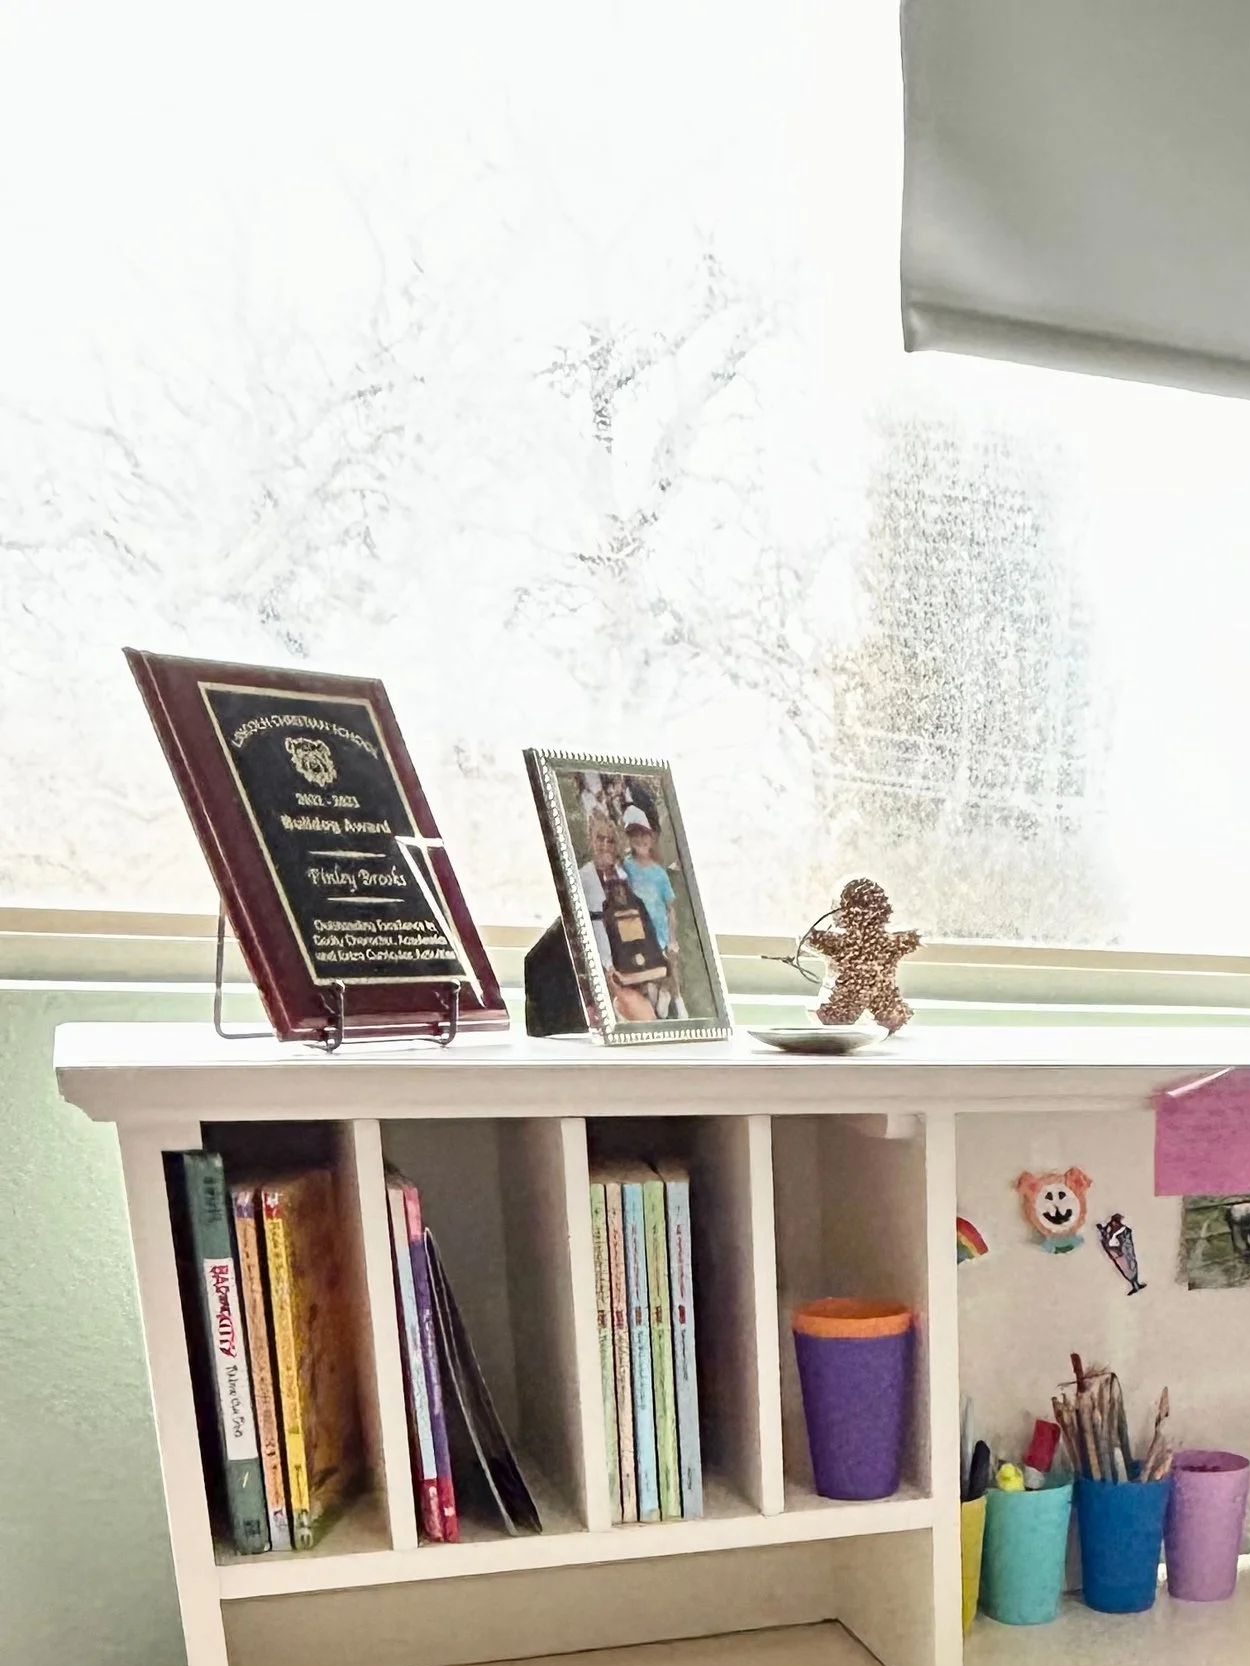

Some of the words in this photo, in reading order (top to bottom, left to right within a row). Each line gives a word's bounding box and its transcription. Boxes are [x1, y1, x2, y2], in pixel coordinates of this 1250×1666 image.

[231, 716, 273, 748] LINCOLN
[270, 714, 331, 732] CHRISTIAN
[332, 723, 379, 760] SCHOOL
[280, 814, 342, 835] Bulldog
[344, 817, 393, 835] Award
[307, 865, 358, 893] Finley
[357, 865, 408, 887] Brooks
[313, 918, 377, 933] Outstanding
[314, 950, 339, 961] and
